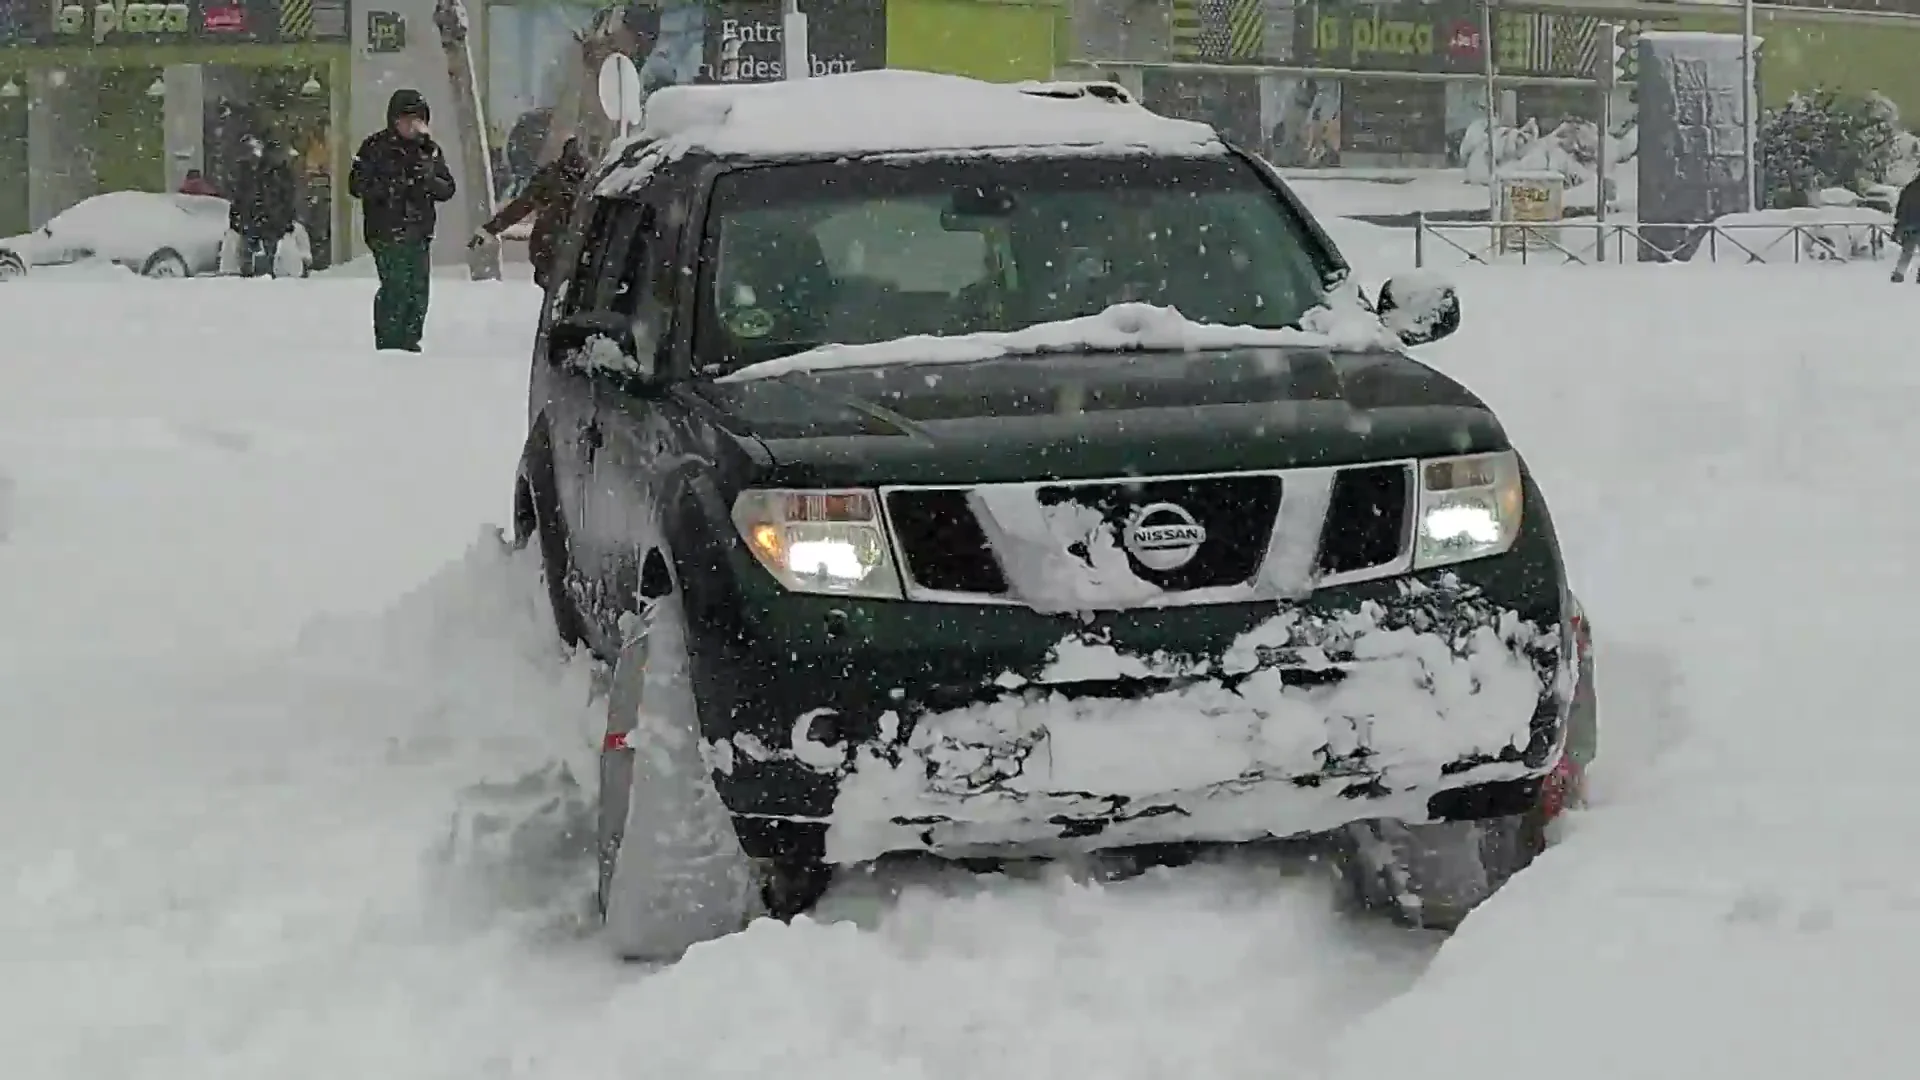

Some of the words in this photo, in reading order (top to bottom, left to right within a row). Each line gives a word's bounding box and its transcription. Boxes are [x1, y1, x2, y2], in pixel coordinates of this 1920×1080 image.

[51, 0, 84, 34] la
[94, 0, 189, 45] plaza
[1313, 2, 1339, 49] la
[1353, 4, 1434, 64] plaza
[740, 54, 855, 78] desbrir
[1134, 528, 1198, 541] NISSAN
